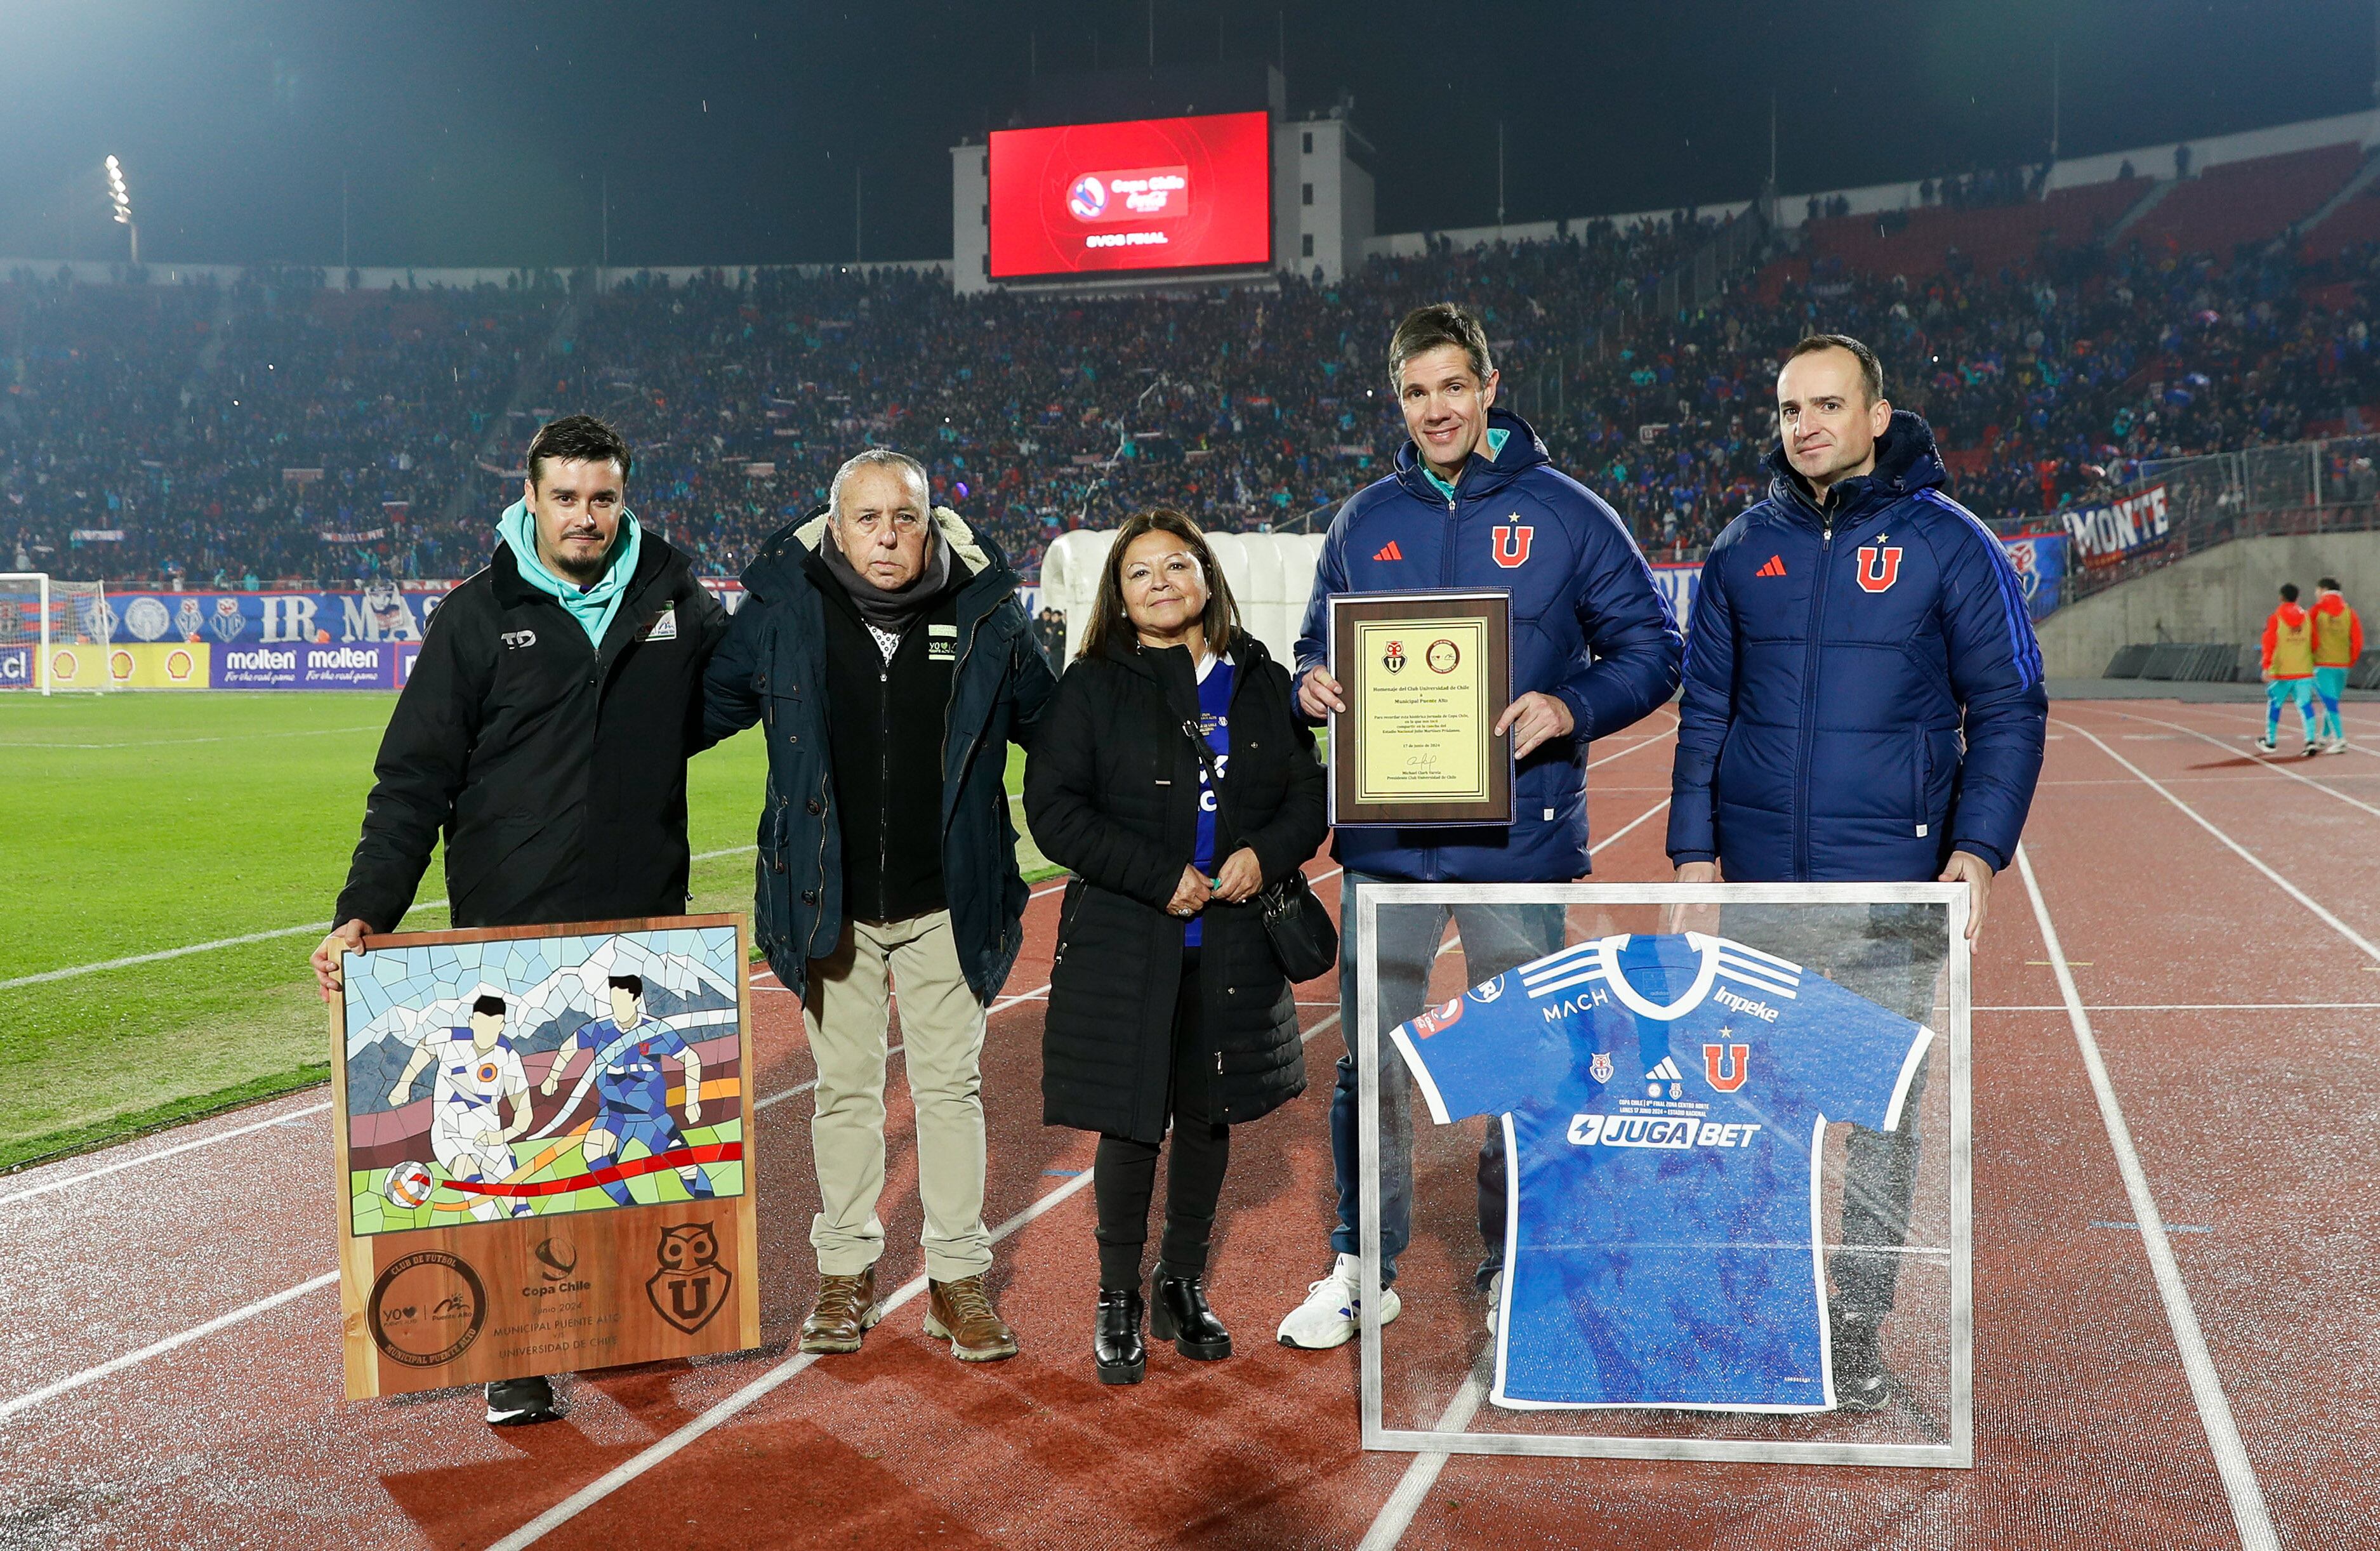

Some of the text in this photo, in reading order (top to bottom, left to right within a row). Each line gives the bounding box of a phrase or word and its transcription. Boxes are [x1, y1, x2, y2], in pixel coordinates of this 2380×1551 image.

[1126, 232, 1168, 246] FINAL
[1492, 525, 1534, 569] U
[1856, 546, 1903, 593] U
[227, 649, 296, 670] molten
[308, 647, 378, 669] molten
[1542, 988, 1610, 1024] MACH
[1713, 985, 1779, 1024] Impeke
[1703, 1043, 1750, 1093] U
[391, 1259, 411, 1275] CLUB
[413, 1255, 424, 1264] DE
[522, 1281, 591, 1297] Copa Chile
[668, 1277, 711, 1319] U
[559, 1302, 582, 1312] 2024
[494, 1322, 551, 1337] MUNICIPAL
[555, 1316, 593, 1329] PUENTE
[385, 1328, 476, 1364] MUNICIPAL PUENTE ALTO
[499, 1342, 569, 1359] UNIVERSIDAD
[573, 1340, 586, 1349] DE
